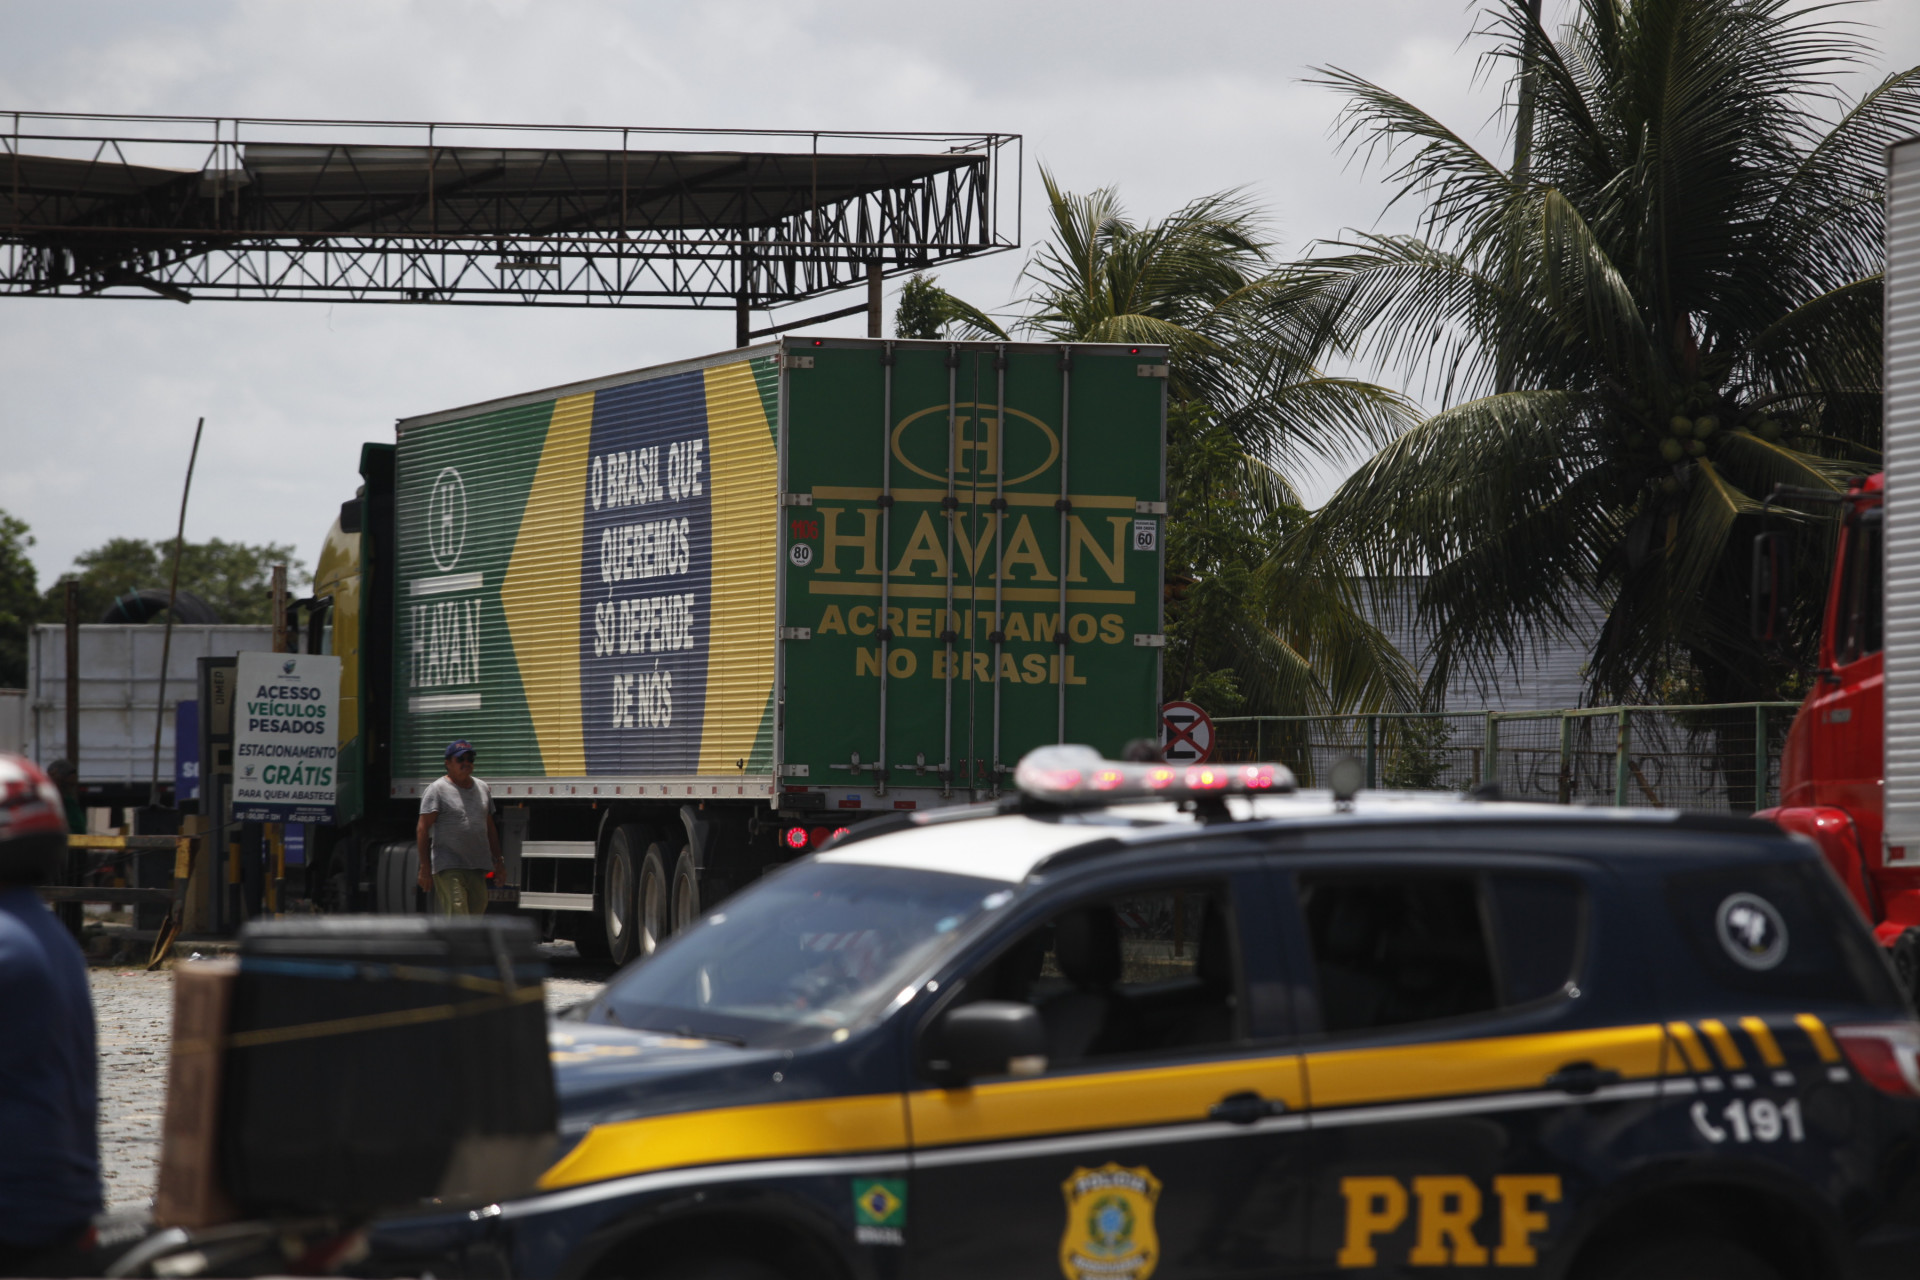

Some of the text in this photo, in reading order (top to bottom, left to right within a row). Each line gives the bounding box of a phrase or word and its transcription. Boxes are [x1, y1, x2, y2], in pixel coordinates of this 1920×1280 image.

[946, 416, 1005, 475] H
[591, 438, 703, 510] O BRASIL QUE
[600, 517, 690, 583] QUEREMOS
[794, 546, 809, 560] 80
[814, 506, 1133, 584] HAVAN
[1138, 532, 1152, 545] 60
[594, 582, 695, 657] SÓ DEPENDE
[816, 604, 1126, 645] ACREDITAMOS
[409, 597, 483, 688] HAVAN
[855, 646, 1088, 685] NO BRASIL
[247, 699, 327, 718] VEÍCULOS
[256, 685, 321, 700] ACESSO
[612, 658, 673, 728] DE NÓS
[249, 718, 325, 734] PESADOS
[237, 743, 337, 759] ESTACIONAMENTO
[262, 761, 333, 786] GRÁTIS
[238, 788, 336, 801] PARA QUEM ABASTECE
[1722, 1098, 1805, 1142] 191
[1337, 1174, 1562, 1267] PRF
